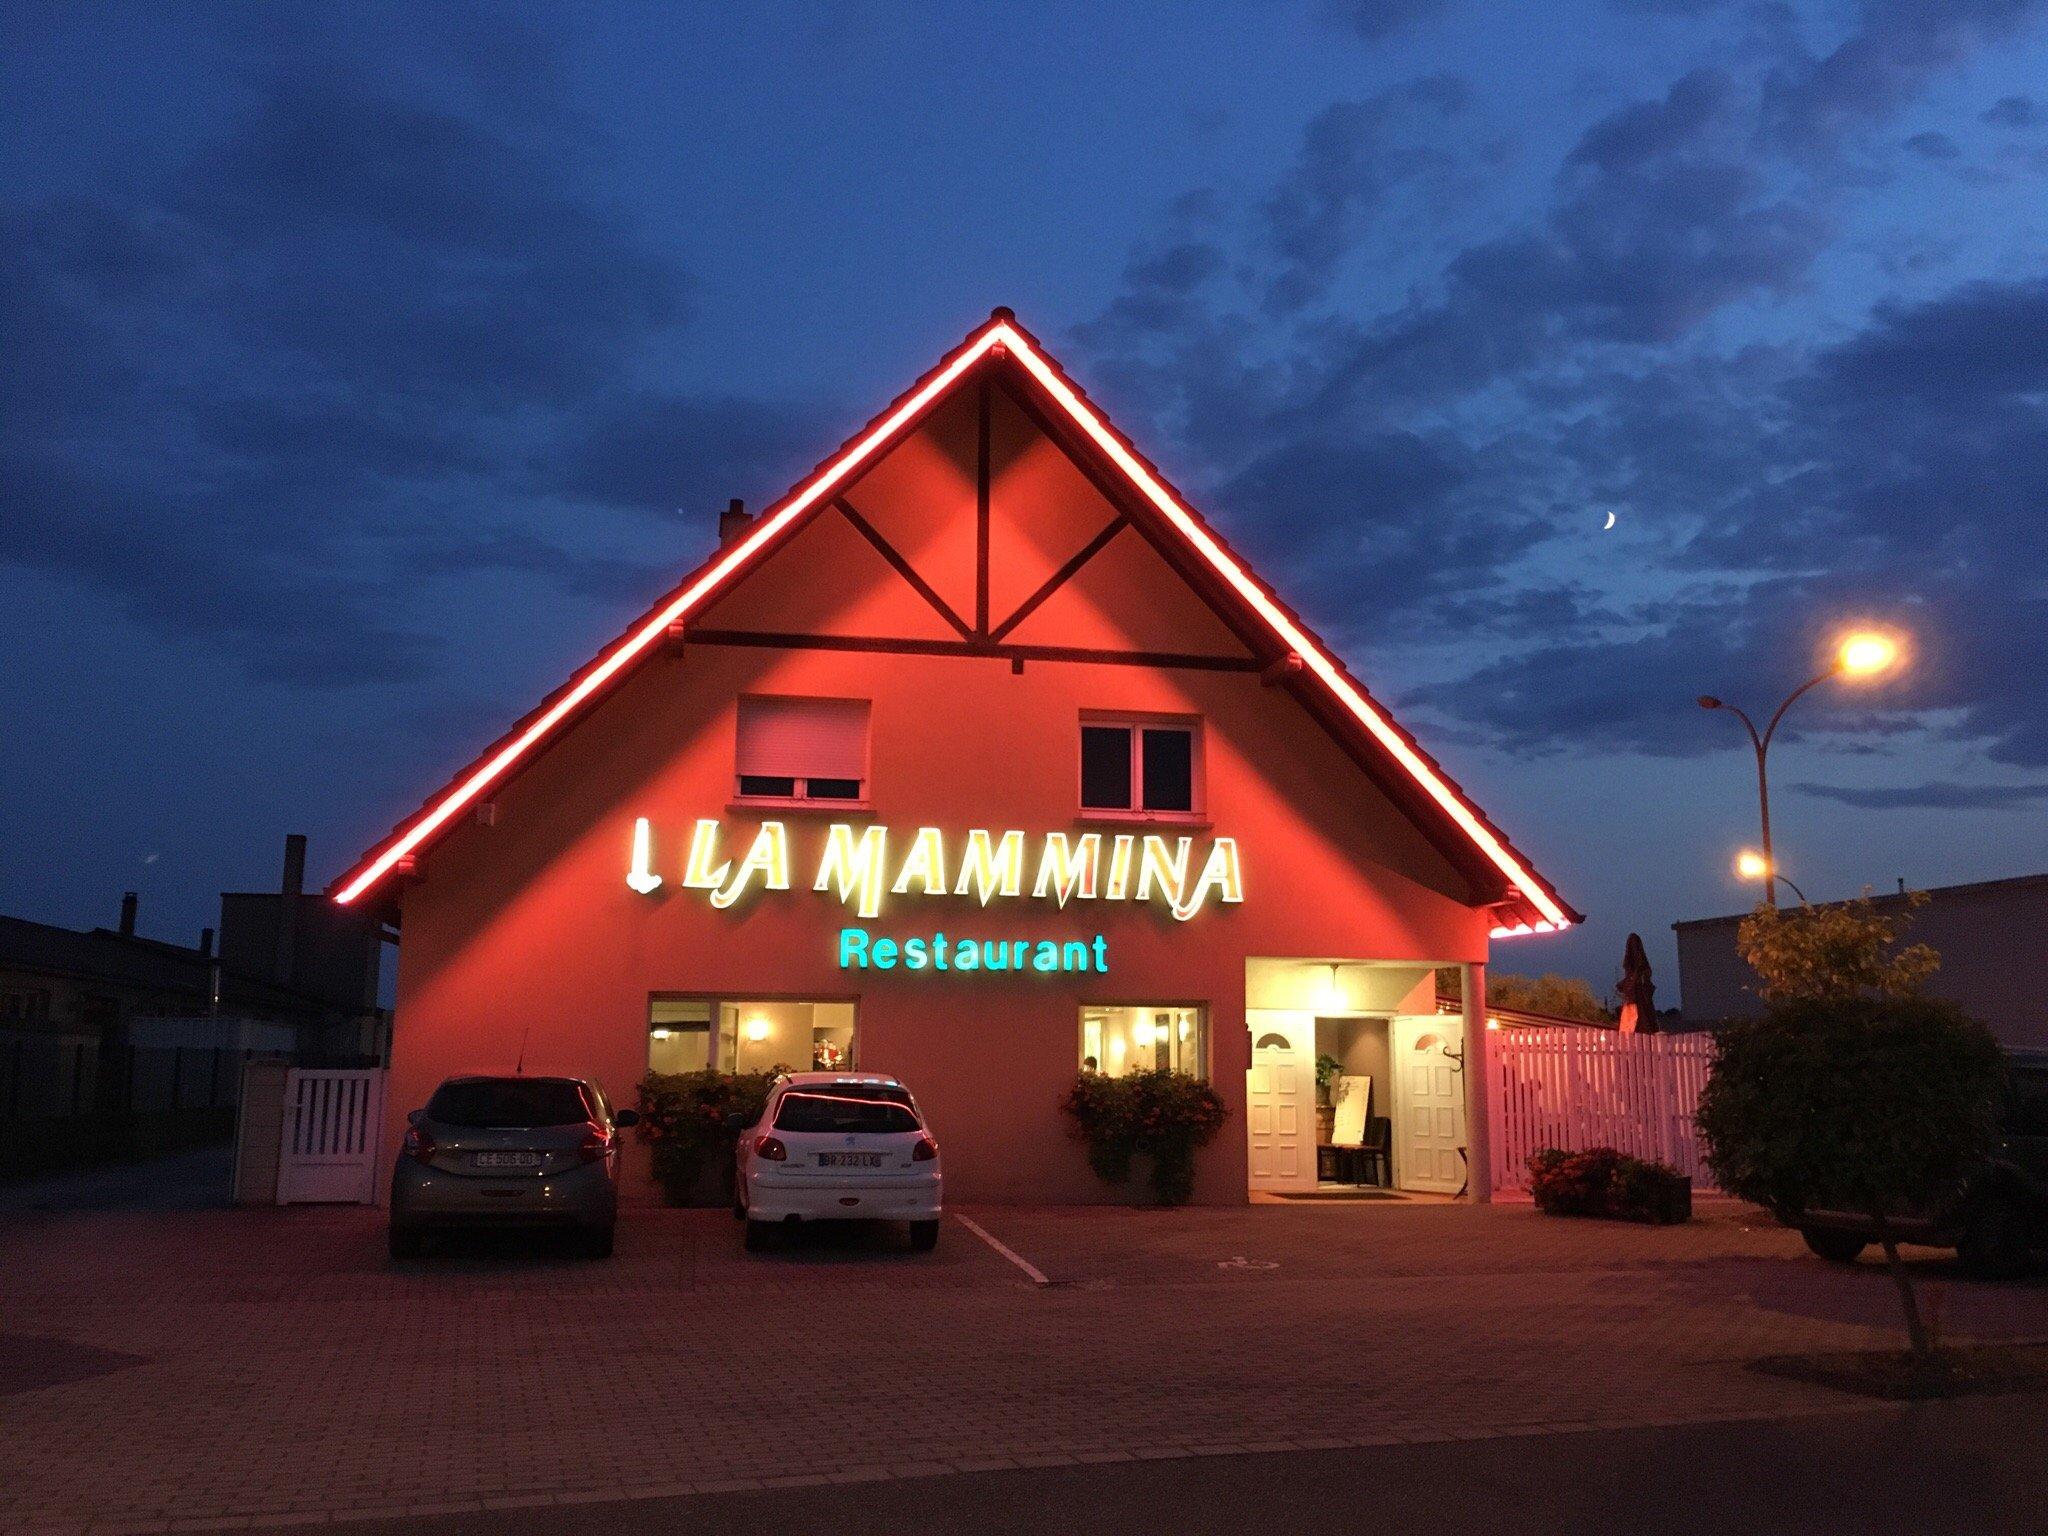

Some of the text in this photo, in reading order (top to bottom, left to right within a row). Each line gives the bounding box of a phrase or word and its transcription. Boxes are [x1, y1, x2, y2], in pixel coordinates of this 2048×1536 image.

[682, 818, 1244, 921] LA MAMMINA
[839, 927, 1109, 974] Restaurant
